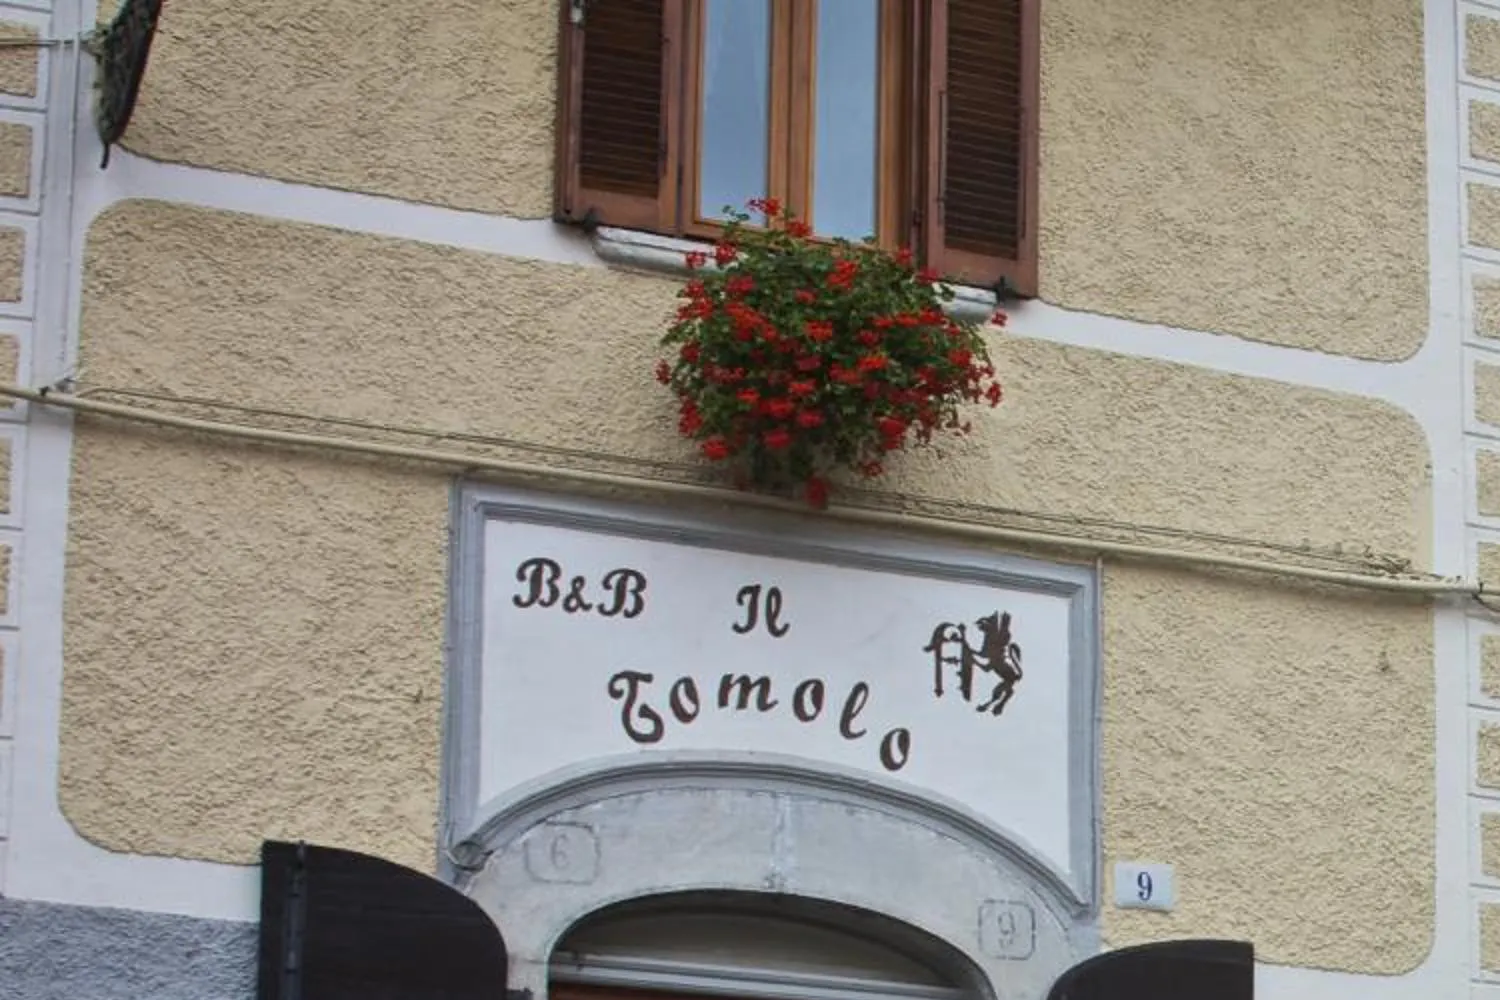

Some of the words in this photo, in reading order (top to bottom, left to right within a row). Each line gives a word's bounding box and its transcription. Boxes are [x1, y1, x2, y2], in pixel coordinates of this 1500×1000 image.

[512, 557, 648, 618] B&B
[731, 583, 791, 638] Il
[607, 669, 911, 771] Tomolo
[1136, 871, 1154, 901] 9
